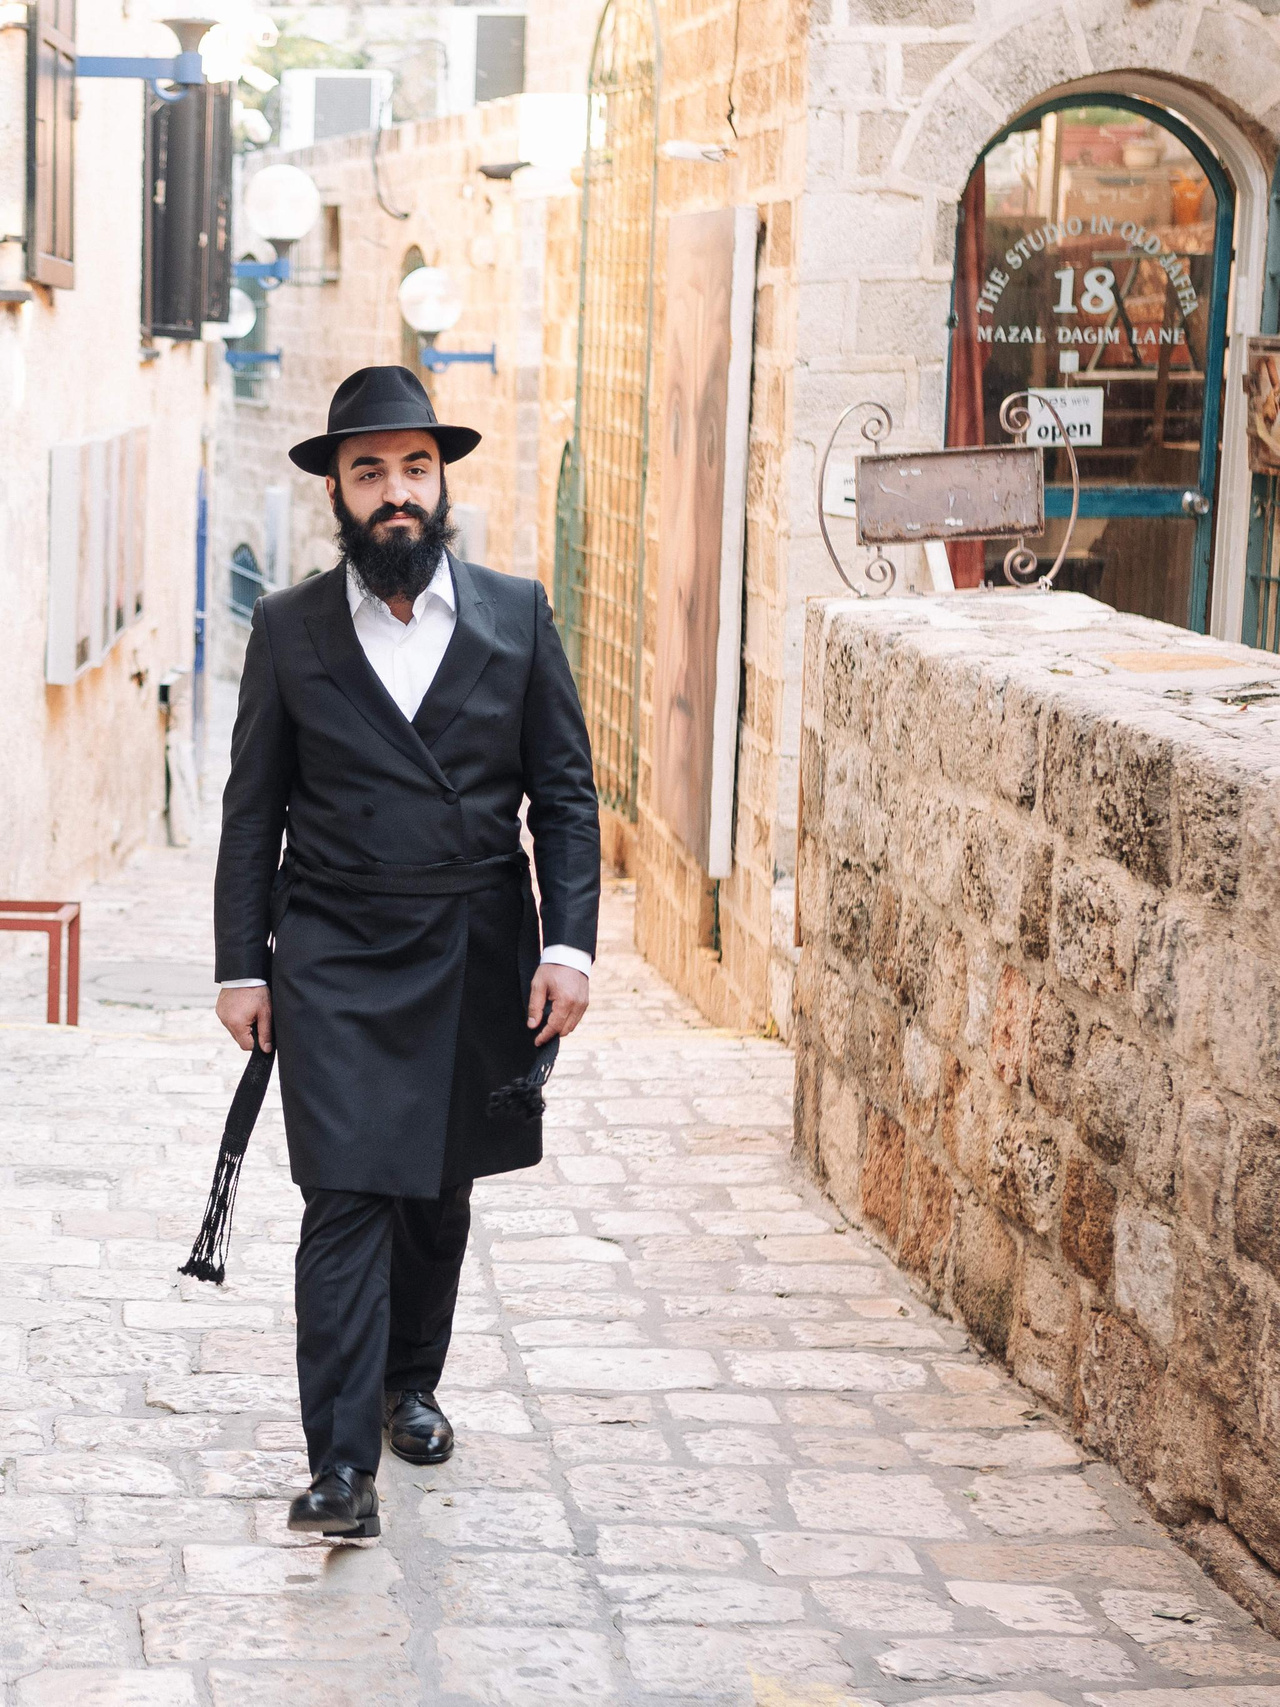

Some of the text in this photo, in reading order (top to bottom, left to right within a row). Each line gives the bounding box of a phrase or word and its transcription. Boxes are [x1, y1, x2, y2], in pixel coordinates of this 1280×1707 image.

[976, 213, 1200, 318] THE STUDIO IN OLD JAFFA
[1052, 266, 1117, 315] 18
[976, 325, 1187, 346] MAZAL DAGIM LANE
[1037, 422, 1092, 443] open
